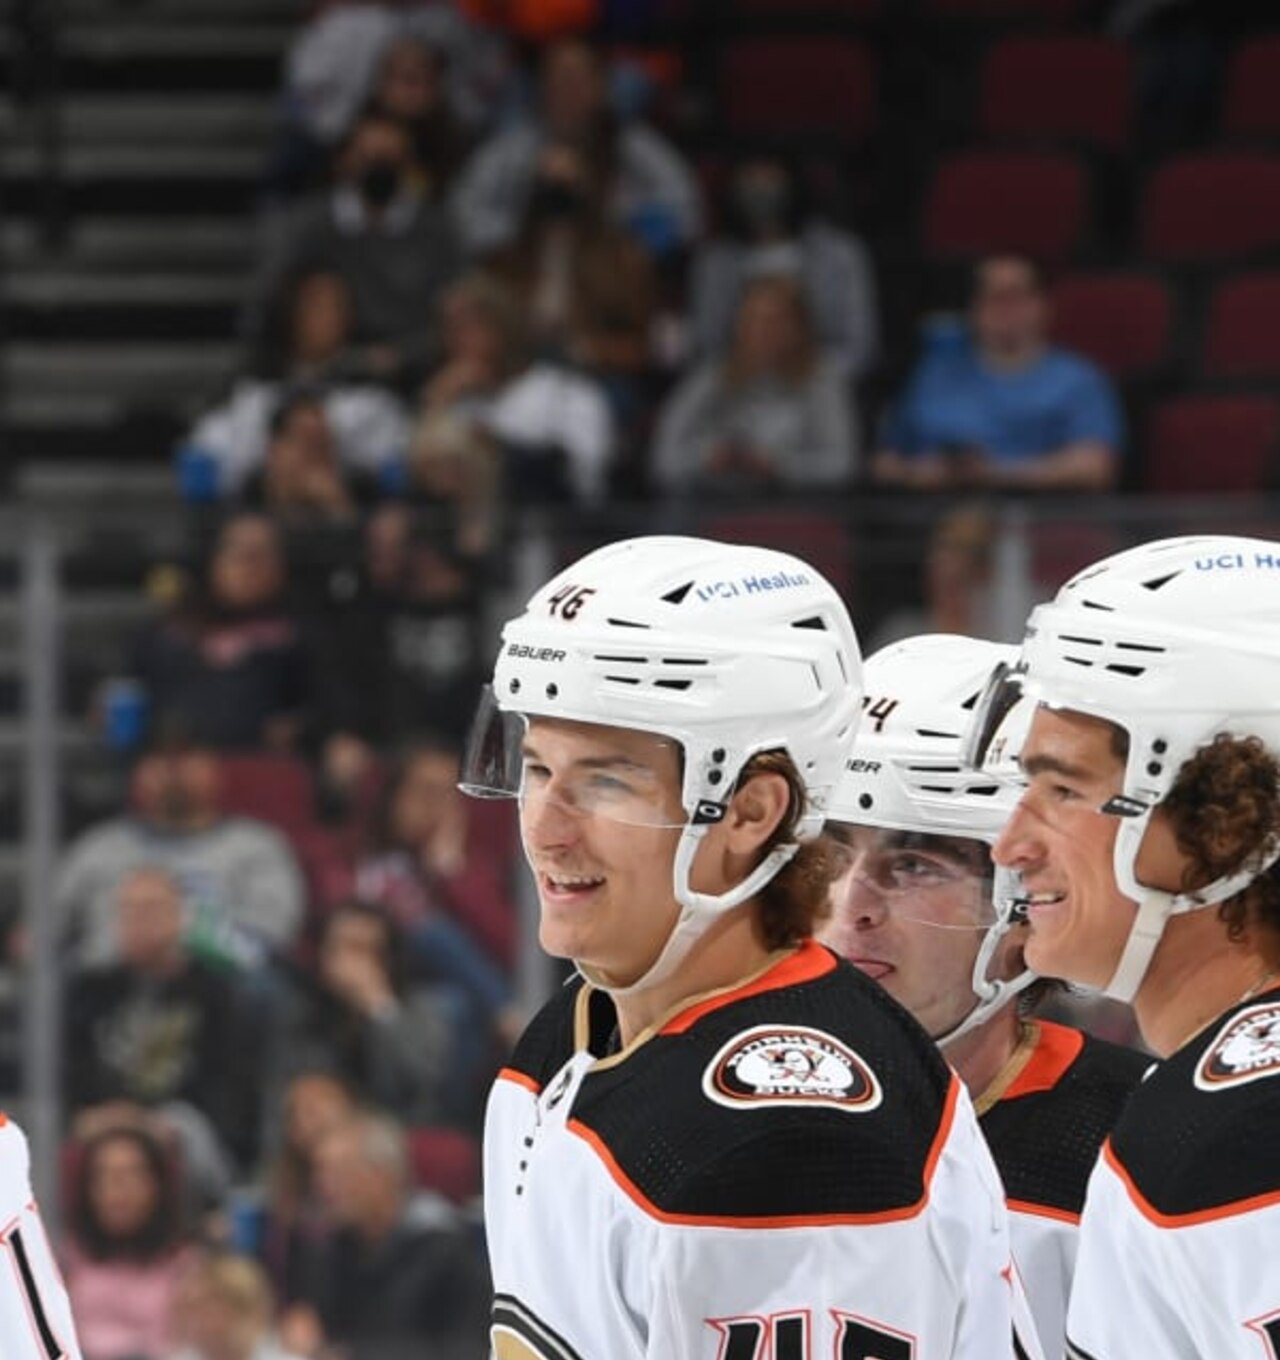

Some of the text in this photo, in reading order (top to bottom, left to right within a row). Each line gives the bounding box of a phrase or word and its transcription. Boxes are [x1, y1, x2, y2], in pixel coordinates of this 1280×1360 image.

[1194, 553, 1245, 572] UCI
[547, 584, 597, 622] 46
[862, 695, 899, 733] 4
